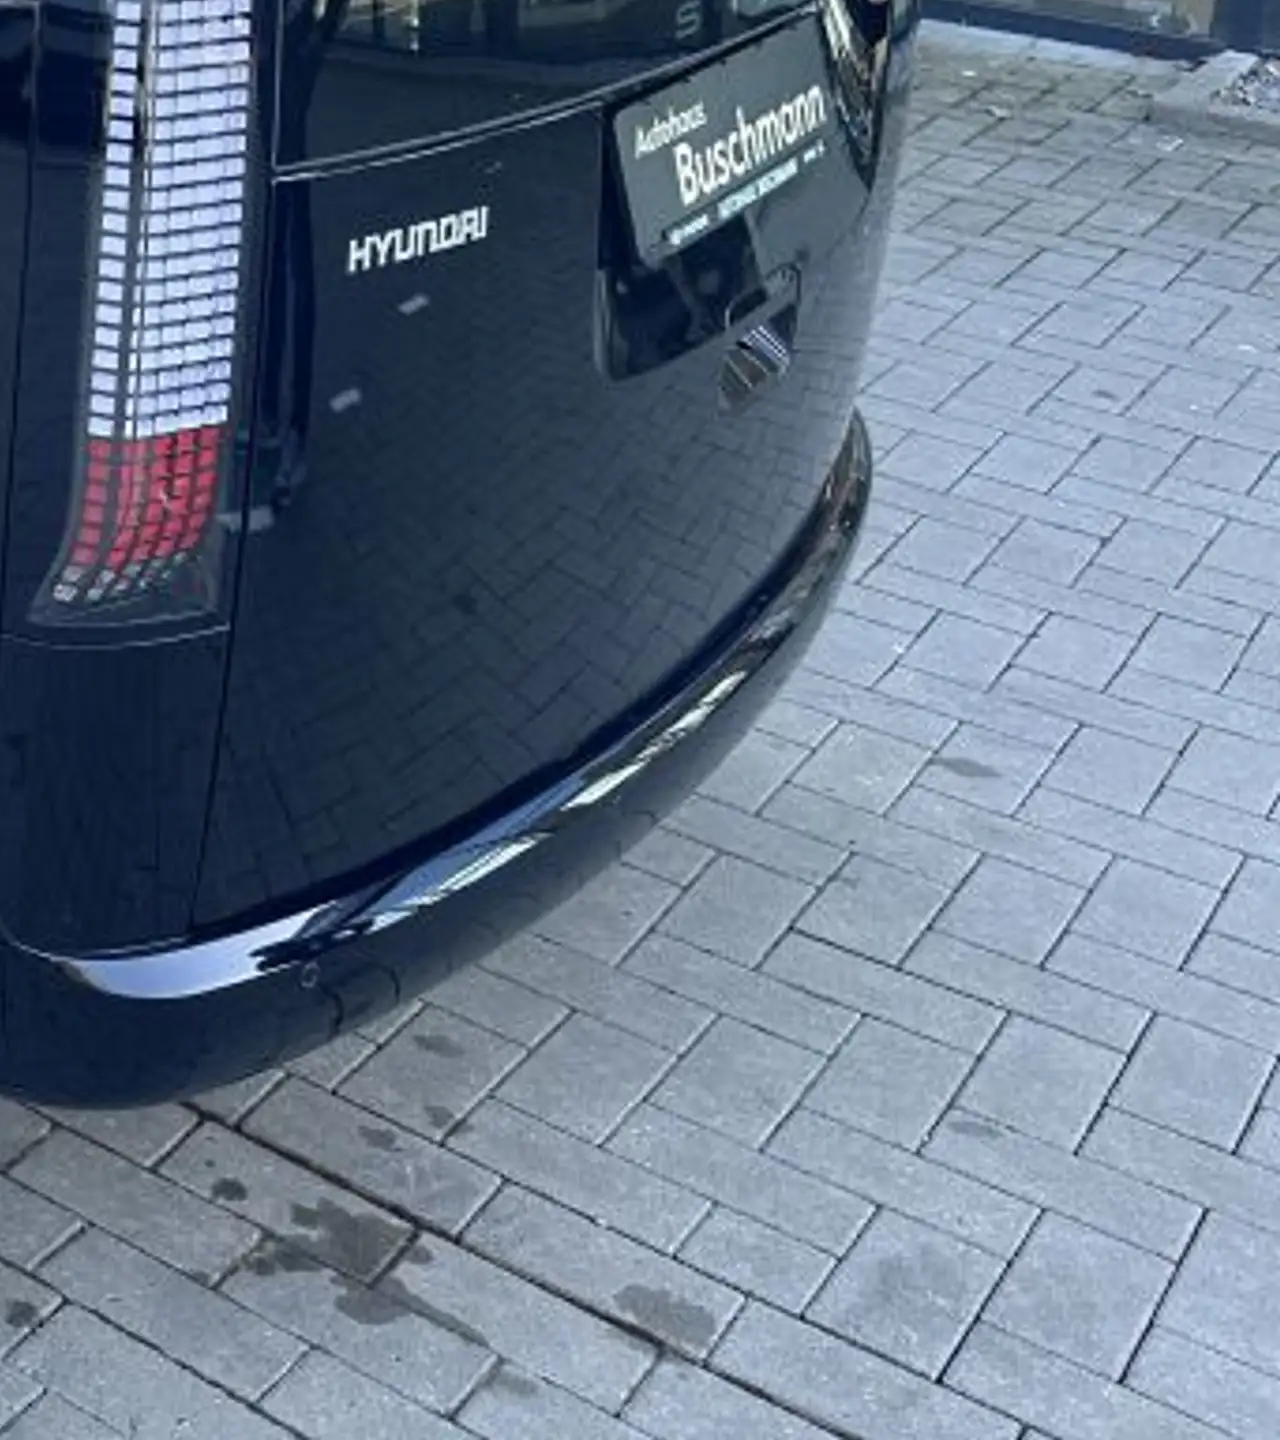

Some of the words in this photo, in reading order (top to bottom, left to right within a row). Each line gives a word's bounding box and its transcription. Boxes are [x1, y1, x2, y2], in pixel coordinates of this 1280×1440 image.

[634, 101, 708, 159] Autohaus
[673, 84, 827, 207] Buschmann
[347, 205, 490, 274] HYUNDAI
